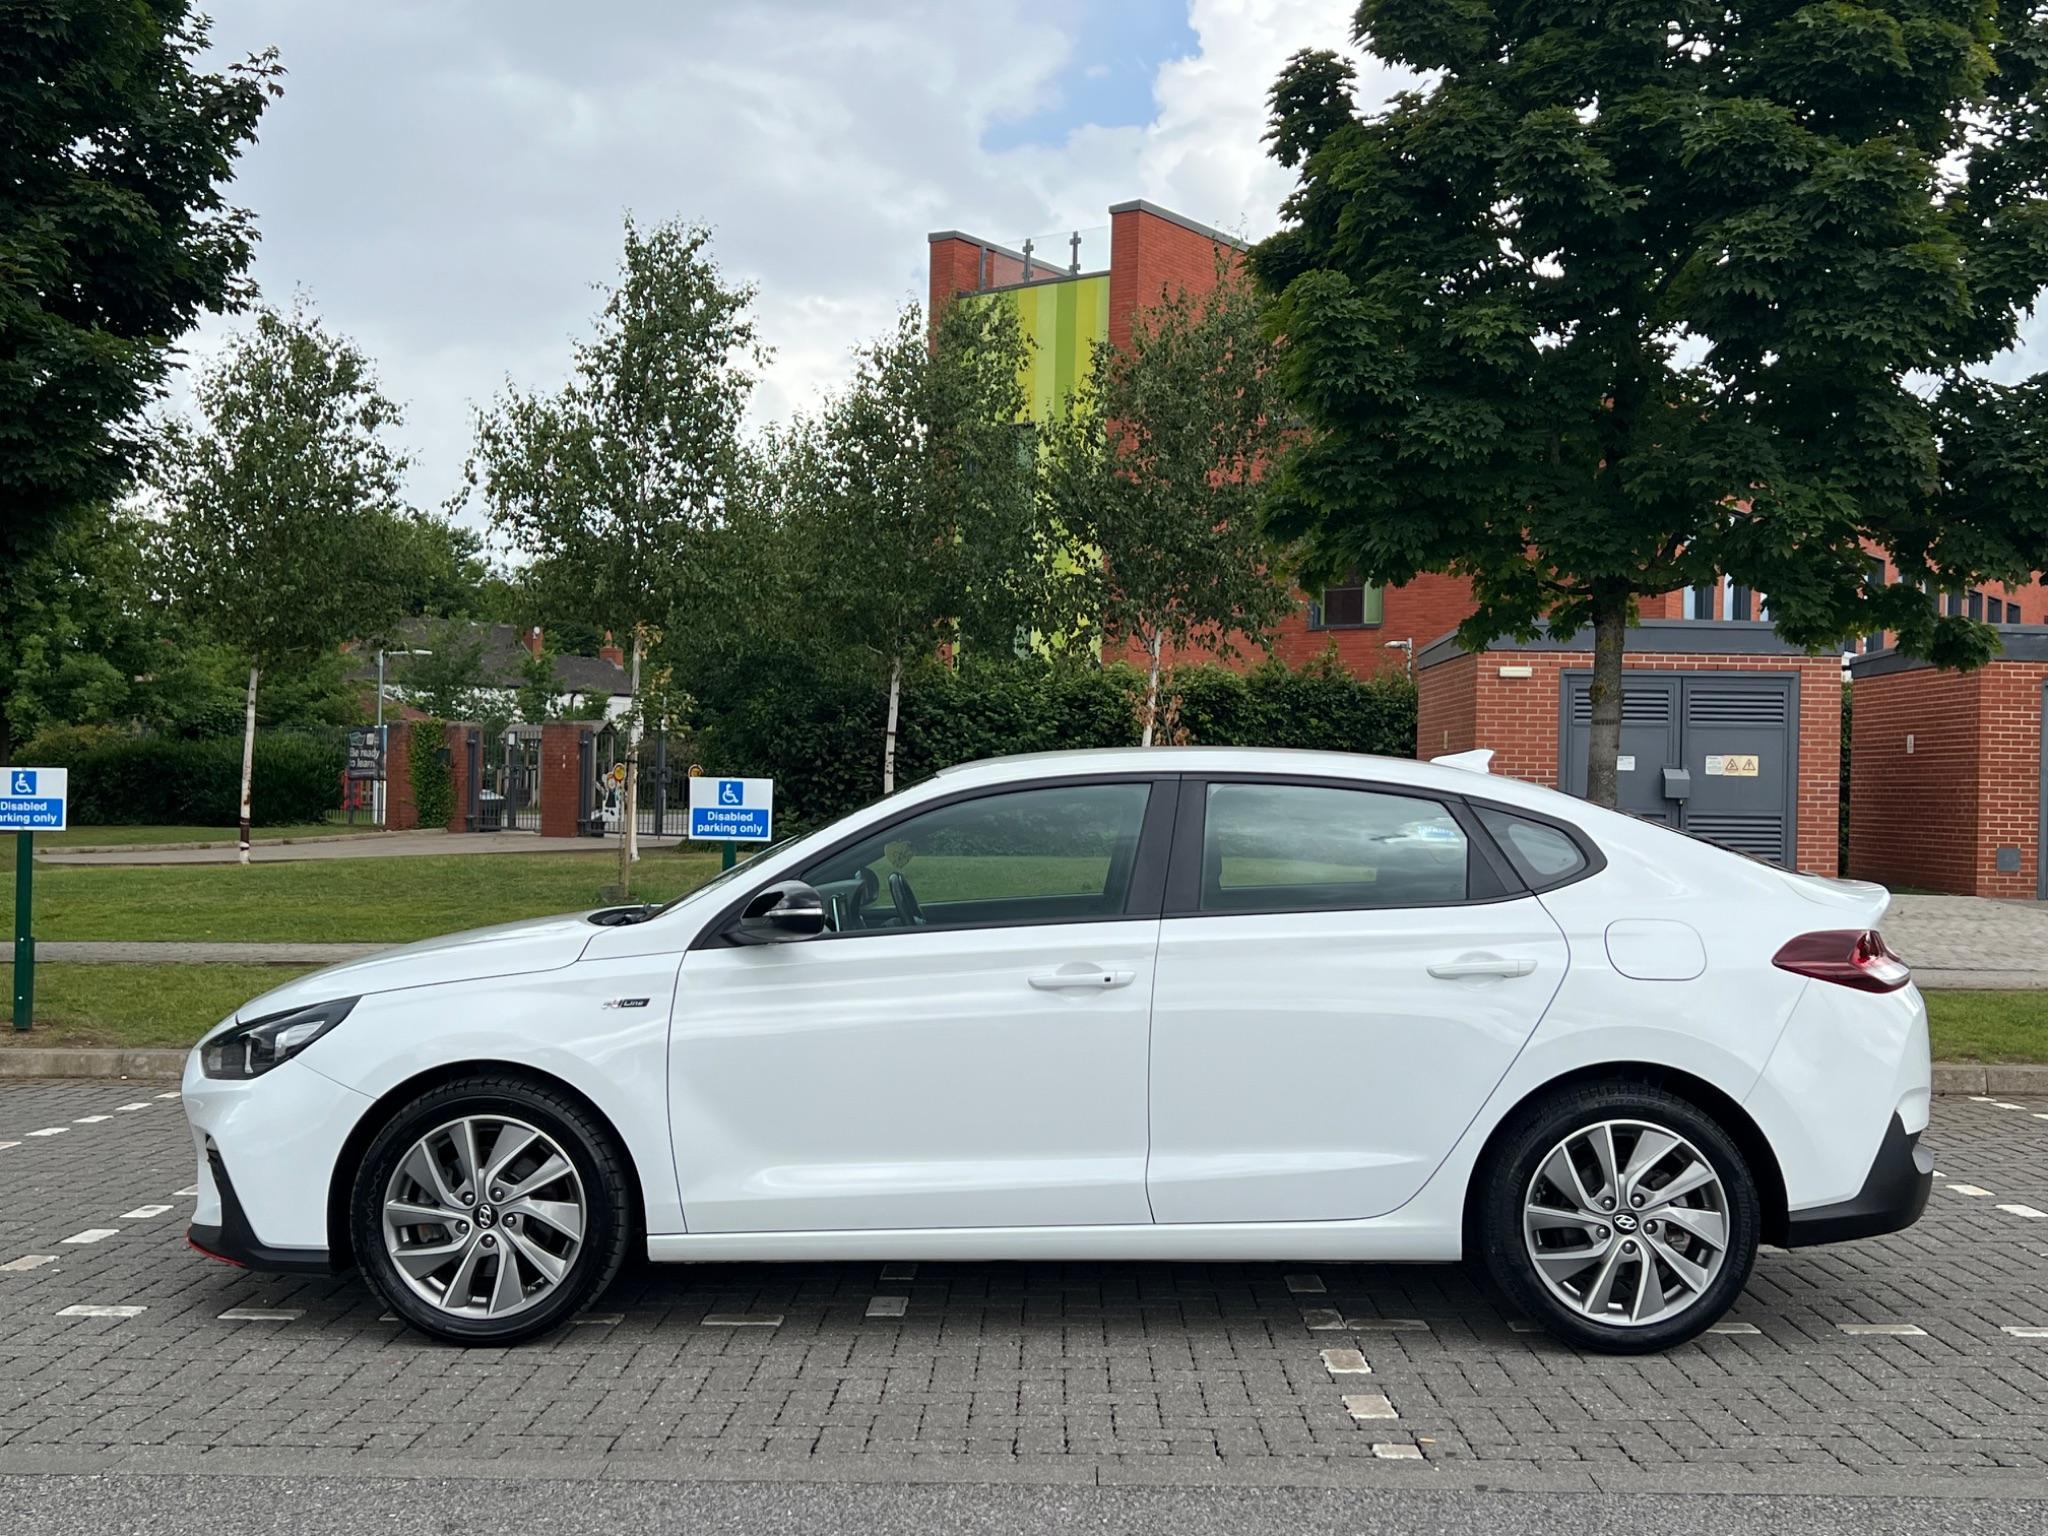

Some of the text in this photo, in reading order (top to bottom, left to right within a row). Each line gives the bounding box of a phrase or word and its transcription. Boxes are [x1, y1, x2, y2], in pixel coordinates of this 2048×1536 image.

[360, 747, 380, 760] ready
[0, 801, 47, 811] Disabled
[33, 814, 57, 824] only
[707, 811, 753, 822] Disabled
[697, 823, 763, 835] parking only
